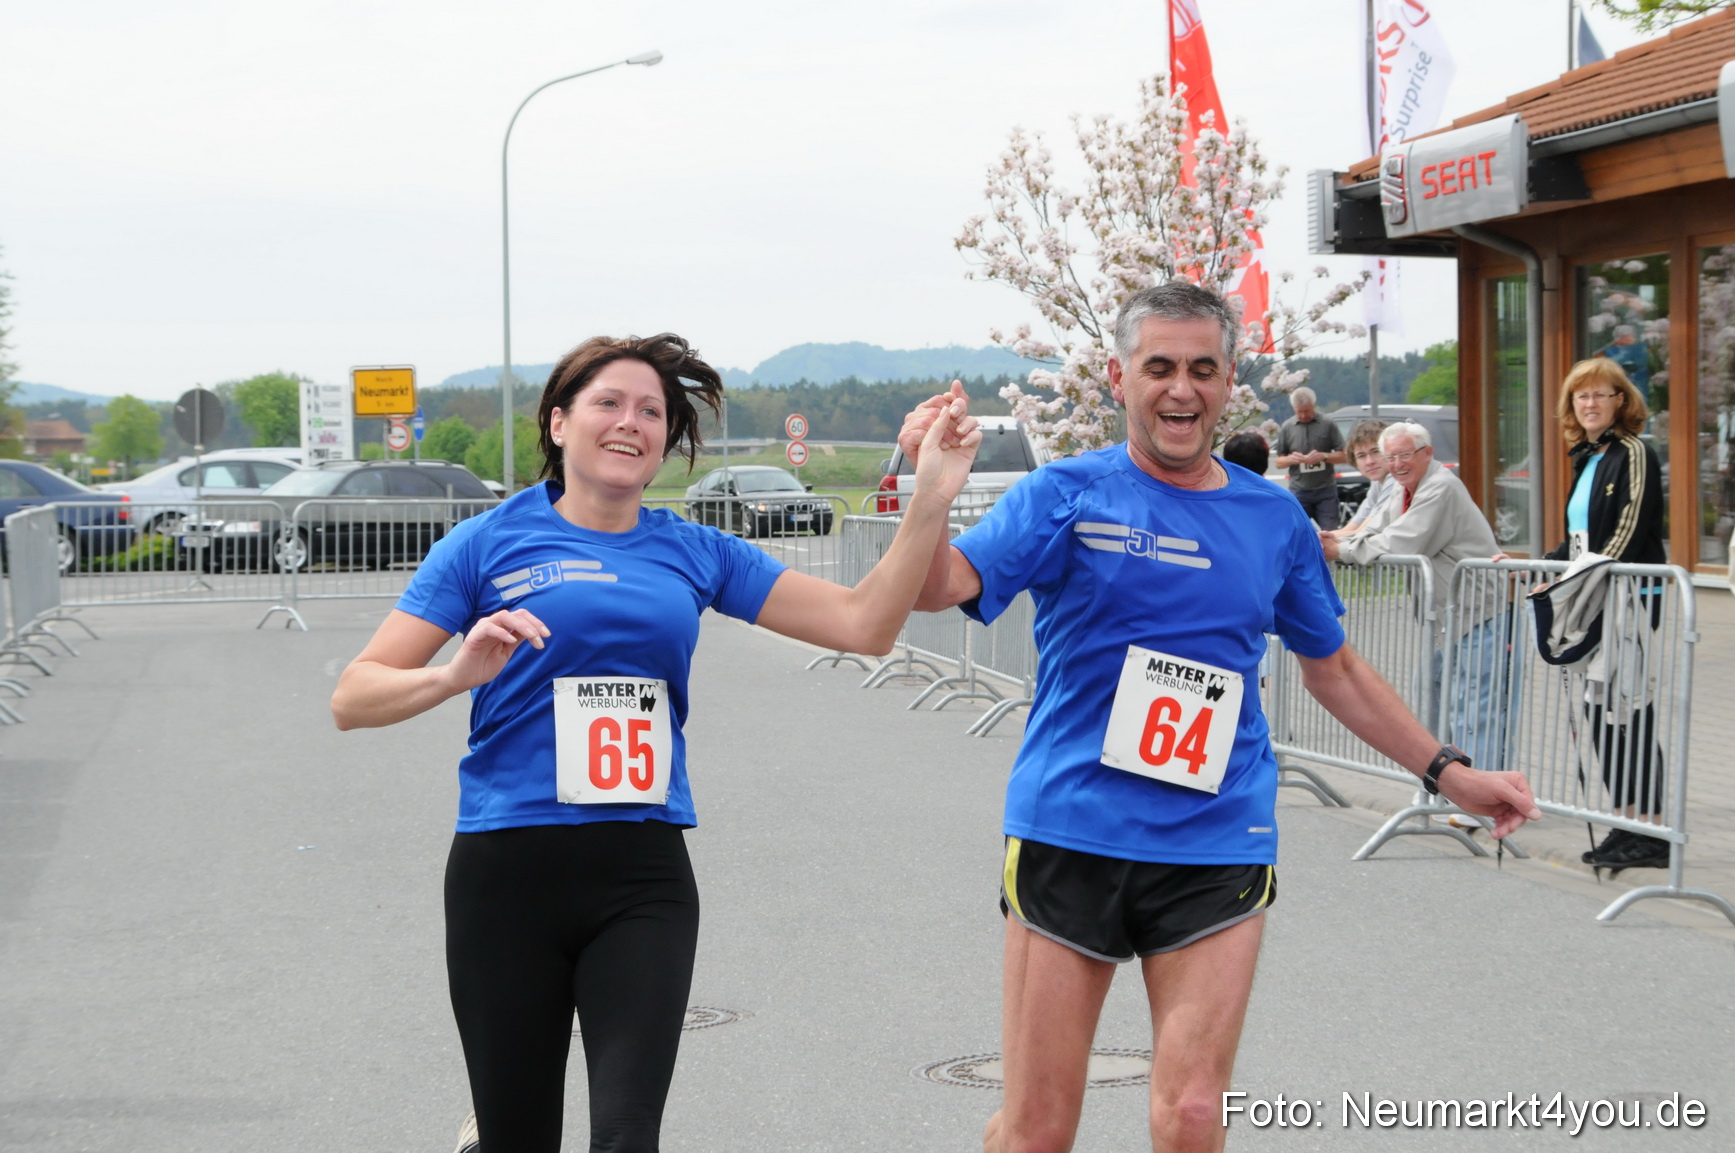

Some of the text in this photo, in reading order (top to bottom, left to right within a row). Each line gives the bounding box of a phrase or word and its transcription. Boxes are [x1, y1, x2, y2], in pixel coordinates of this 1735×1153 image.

[1391, 51, 1432, 140] Surprise
[1421, 150, 1497, 199] SEAT
[359, 385, 409, 397] Neumarkt
[791, 421, 804, 433] 60
[1145, 671, 1203, 695] WERBUNG
[1147, 657, 1206, 685] MEYER
[577, 683, 636, 697] MEYER
[578, 698, 637, 709] WERBUNG
[1138, 696, 1214, 776] 64
[588, 716, 655, 792] 65
